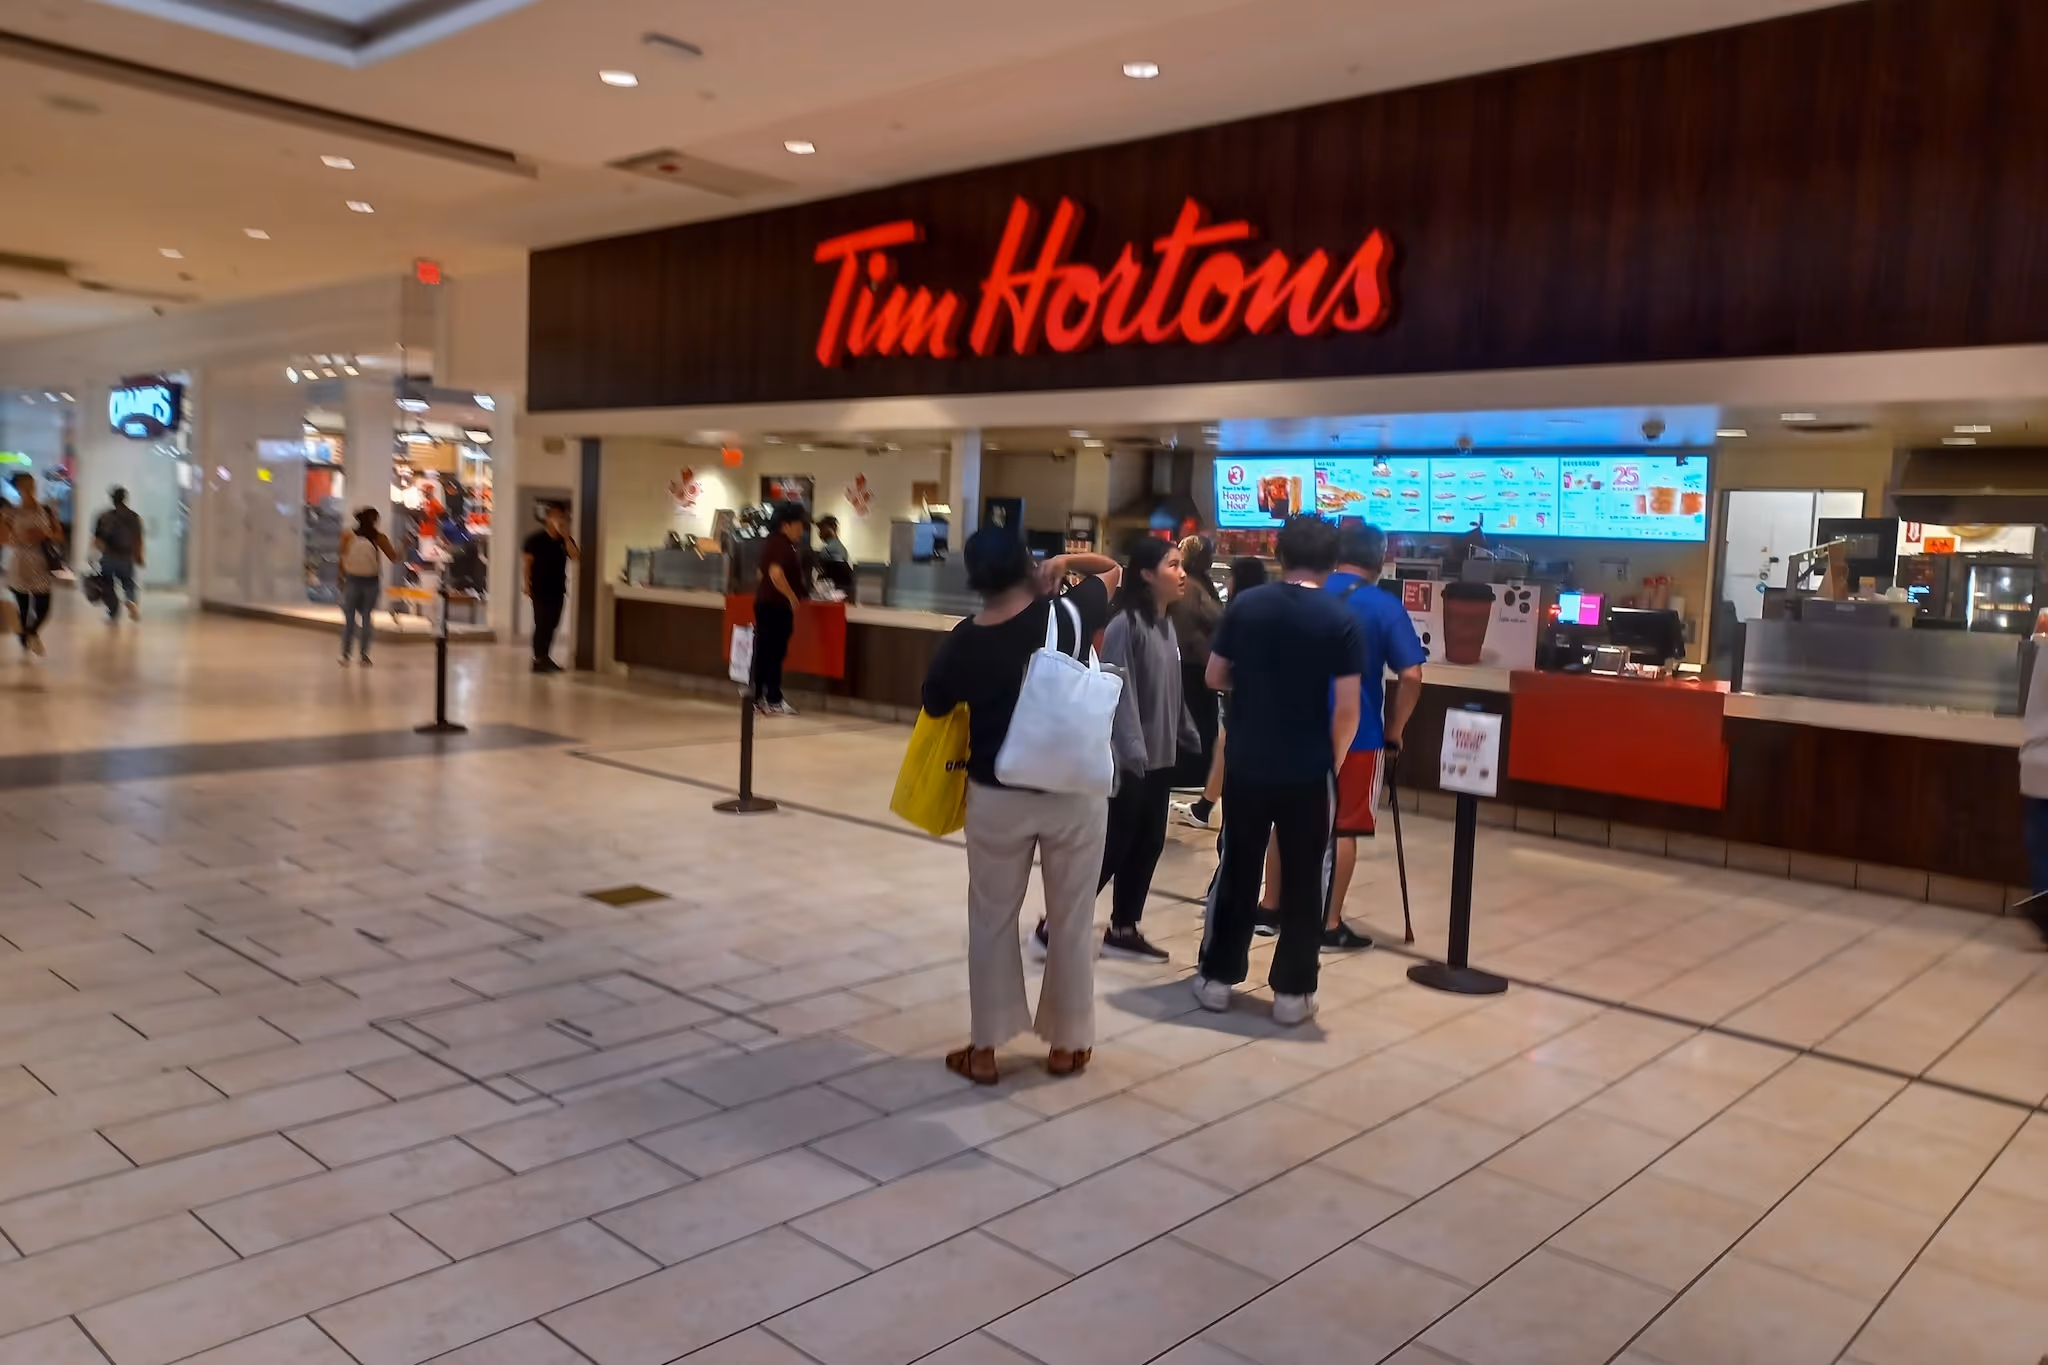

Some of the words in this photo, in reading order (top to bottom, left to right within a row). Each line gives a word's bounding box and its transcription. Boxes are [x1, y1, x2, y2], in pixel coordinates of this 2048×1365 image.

[814, 219, 960, 368] Tim
[968, 195, 1388, 355] Hortons
[1229, 467, 1243, 485] 3
[1612, 465, 1640, 486] 25
[1222, 491, 1251, 502] Happy
[1226, 501, 1248, 510] Hour
